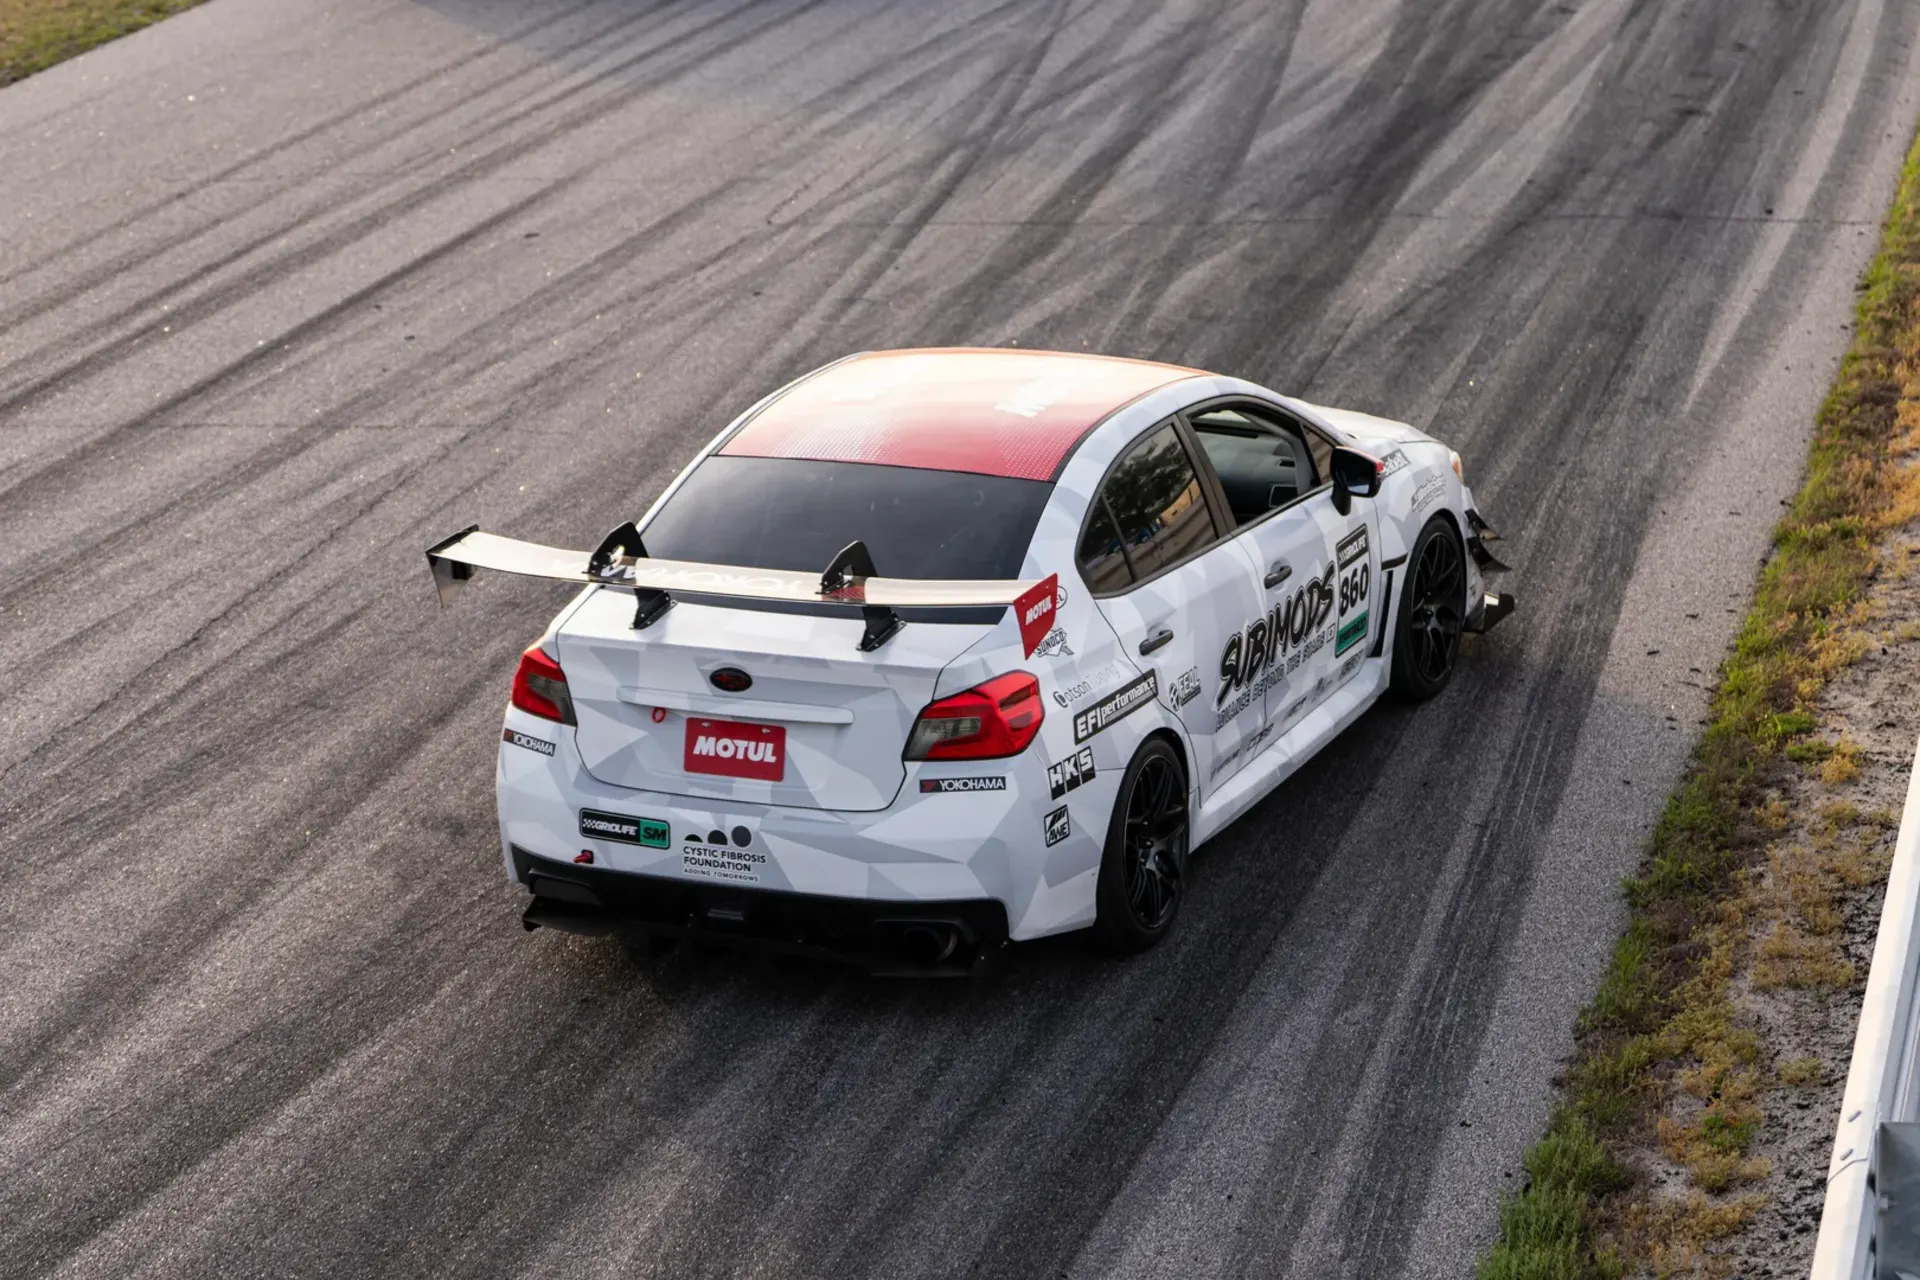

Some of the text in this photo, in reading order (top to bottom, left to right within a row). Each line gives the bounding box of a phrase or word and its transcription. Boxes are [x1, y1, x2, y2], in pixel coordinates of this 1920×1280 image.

[1339, 563, 1369, 617] 860
[1025, 594, 1053, 626] MOTUL
[1036, 630, 1065, 655] SUNOCO
[1217, 560, 1336, 711] SUBIMODS
[1076, 707, 1101, 740] EFI
[1100, 676, 1155, 725] performance
[512, 732, 555, 756] YOKOHAMA
[693, 735, 776, 763] MOTUL
[1049, 748, 1094, 789] HKS
[940, 778, 1005, 790] YOKOHAMA
[595, 820, 667, 842] GRIDLIFE SM
[683, 845, 767, 864] CYSTIC FIBROSIS
[683, 856, 752, 872] FOUNDATION
[684, 867, 759, 882] ADDING TOMORROWS
